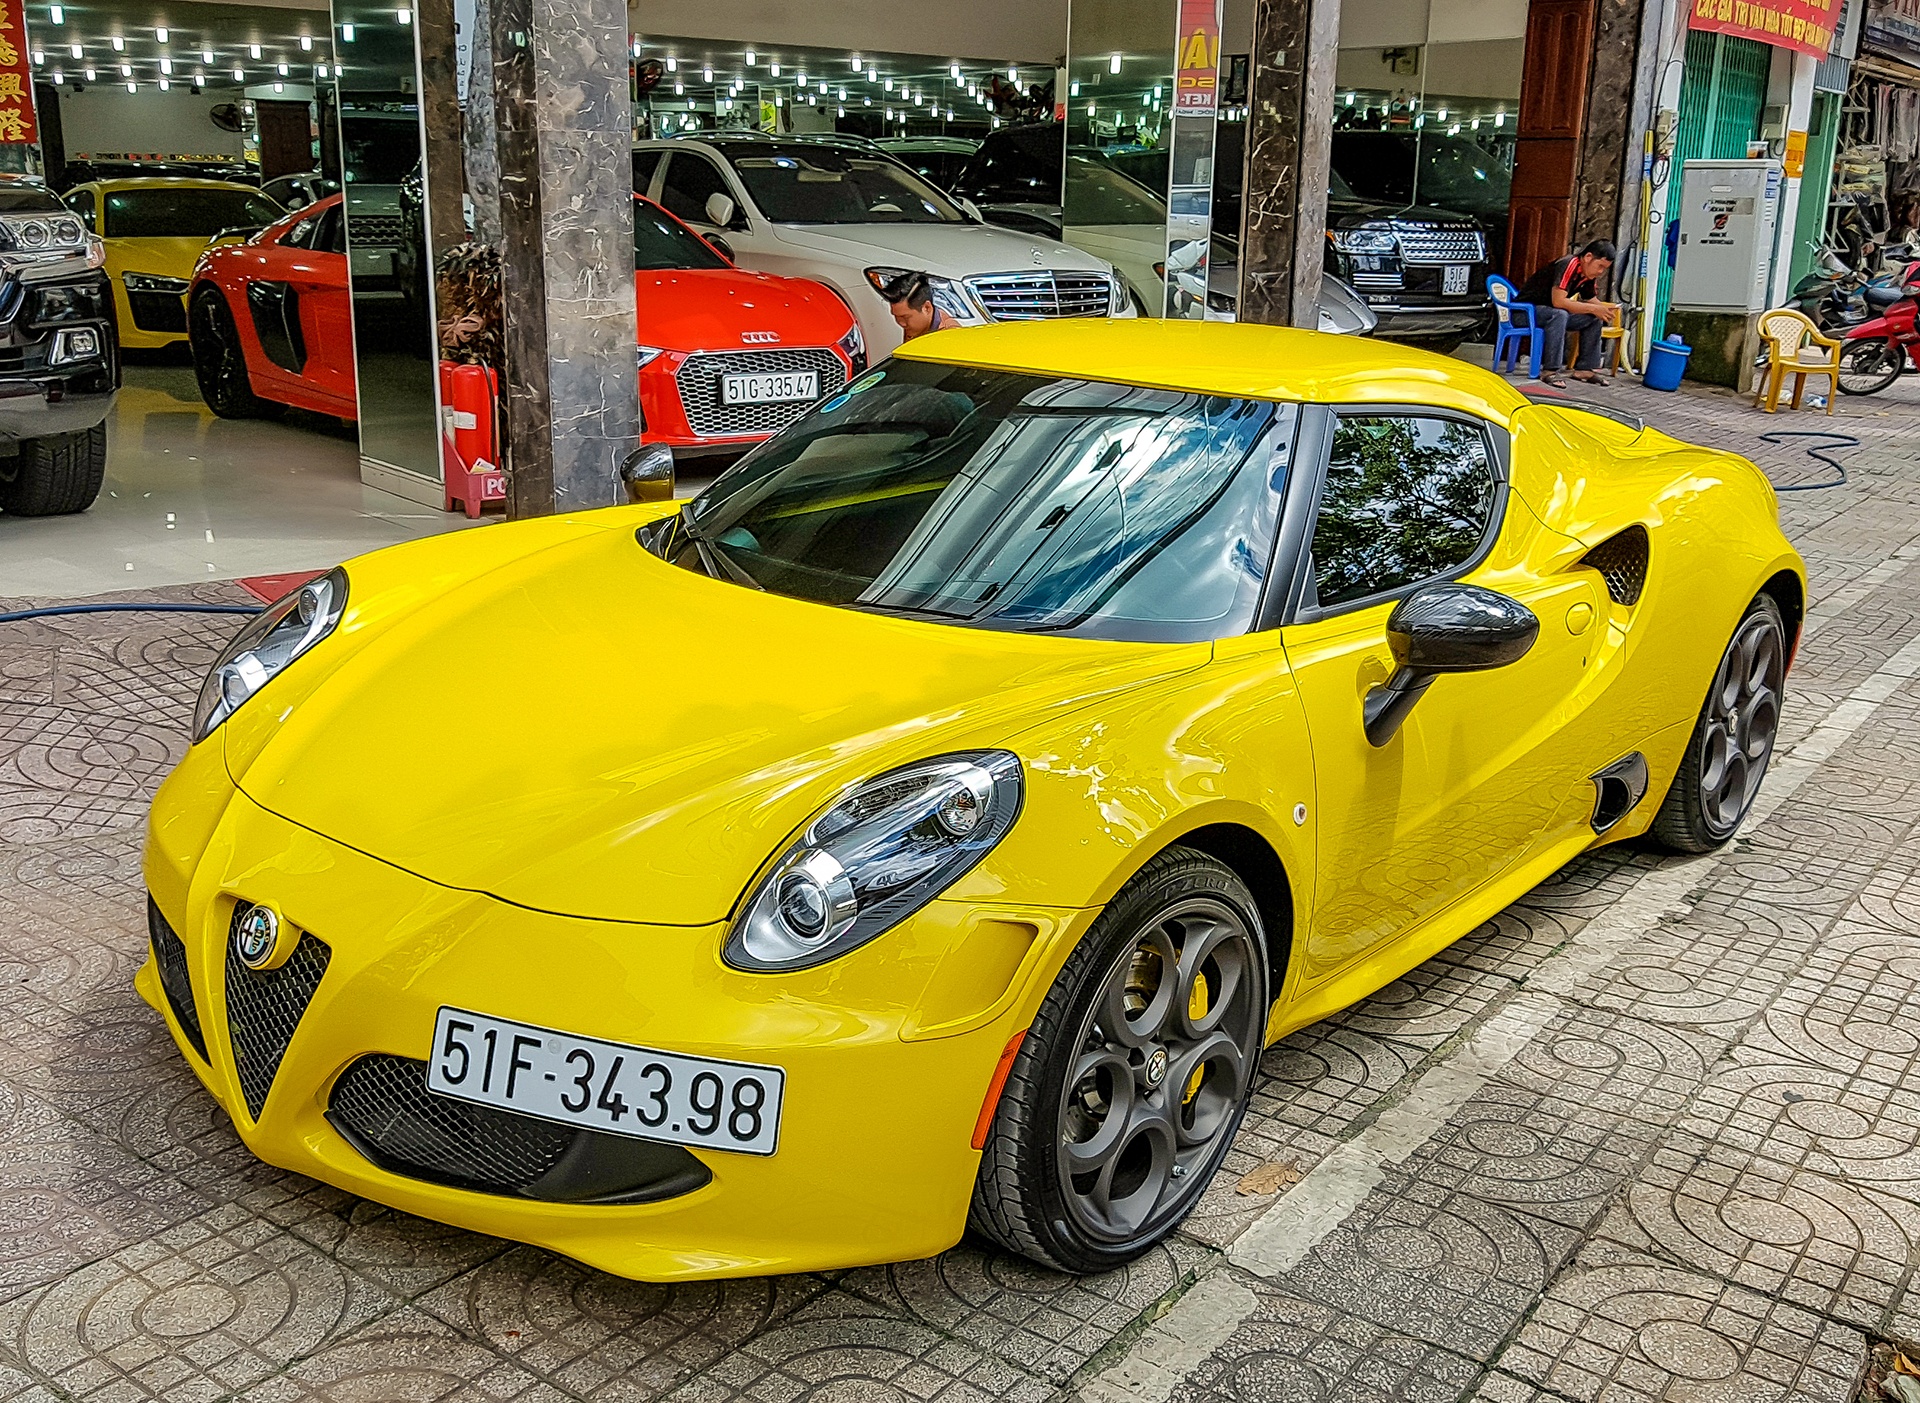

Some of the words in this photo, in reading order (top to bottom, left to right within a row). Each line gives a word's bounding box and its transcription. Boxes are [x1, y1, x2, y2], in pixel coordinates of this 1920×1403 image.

[1450, 267, 1464, 281] 51F
[728, 375, 813, 400] 51G-335.47
[441, 1018, 766, 1142] 51F-343.98
